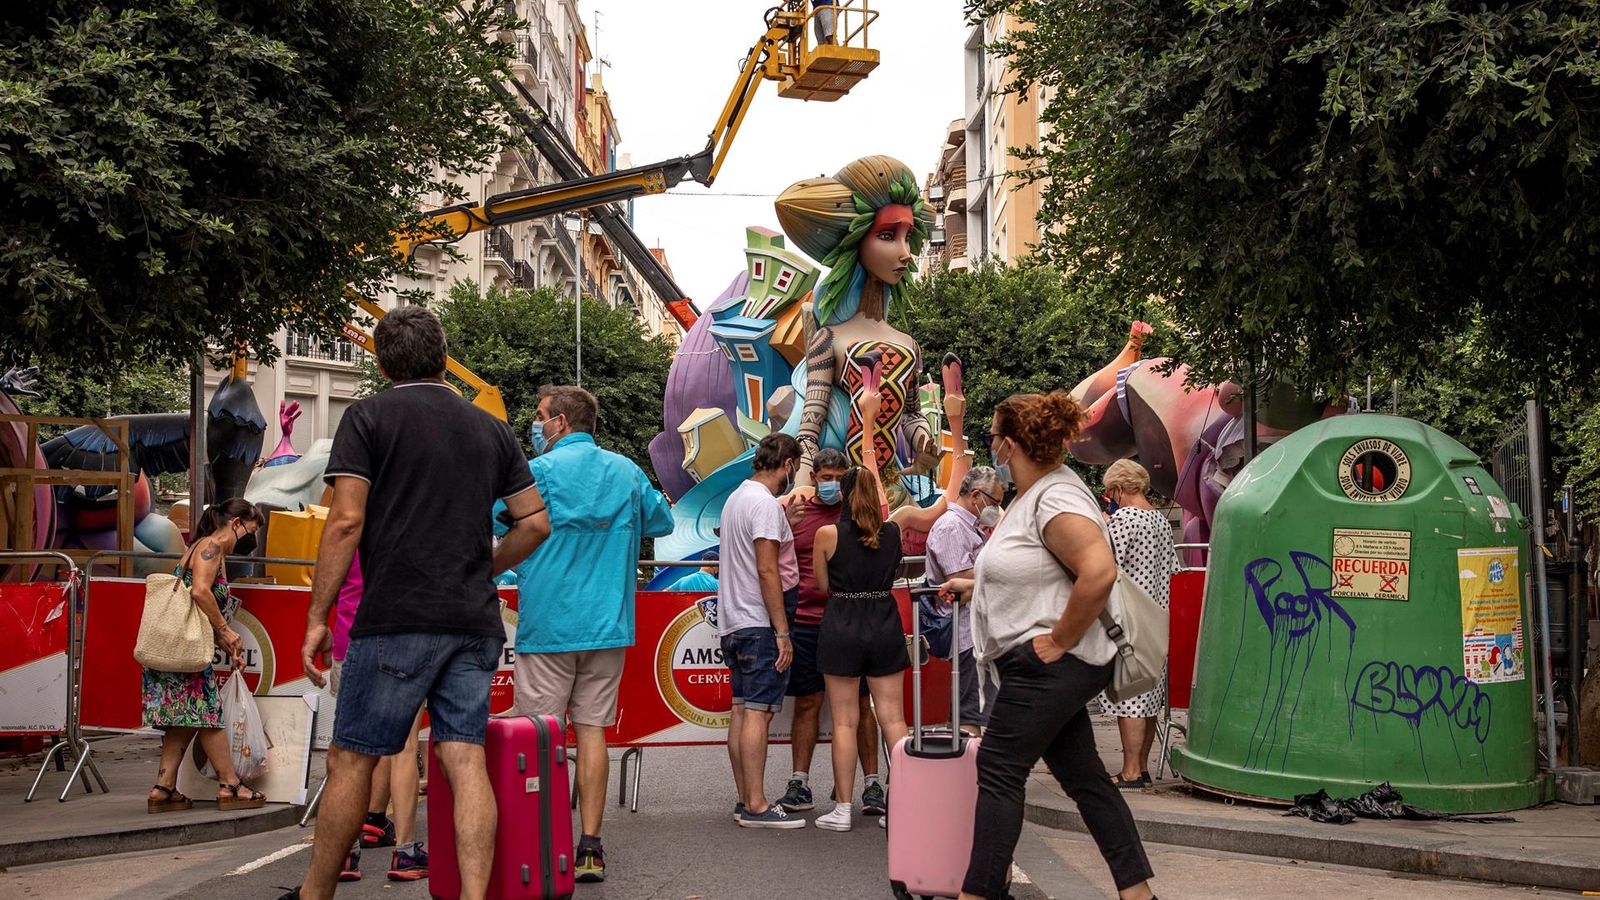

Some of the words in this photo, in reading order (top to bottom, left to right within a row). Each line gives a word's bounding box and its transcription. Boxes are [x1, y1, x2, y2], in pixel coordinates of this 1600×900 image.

[343, 326, 367, 344] LMA
[1342, 452, 1356, 467] SOLS
[1353, 440, 1382, 454] ENVASOS
[1382, 442, 1391, 453] DE
[1390, 447, 1408, 467] VIDRE
[1340, 475, 1353, 490] SOLO
[1388, 478, 1408, 499] VIDRIO
[1334, 558, 1408, 576] RECUERDA
[1333, 590, 1369, 598] PORCELANA
[681, 648, 724, 665] AMS
[687, 674, 730, 684] CERVE
[706, 715, 718, 726] LA
